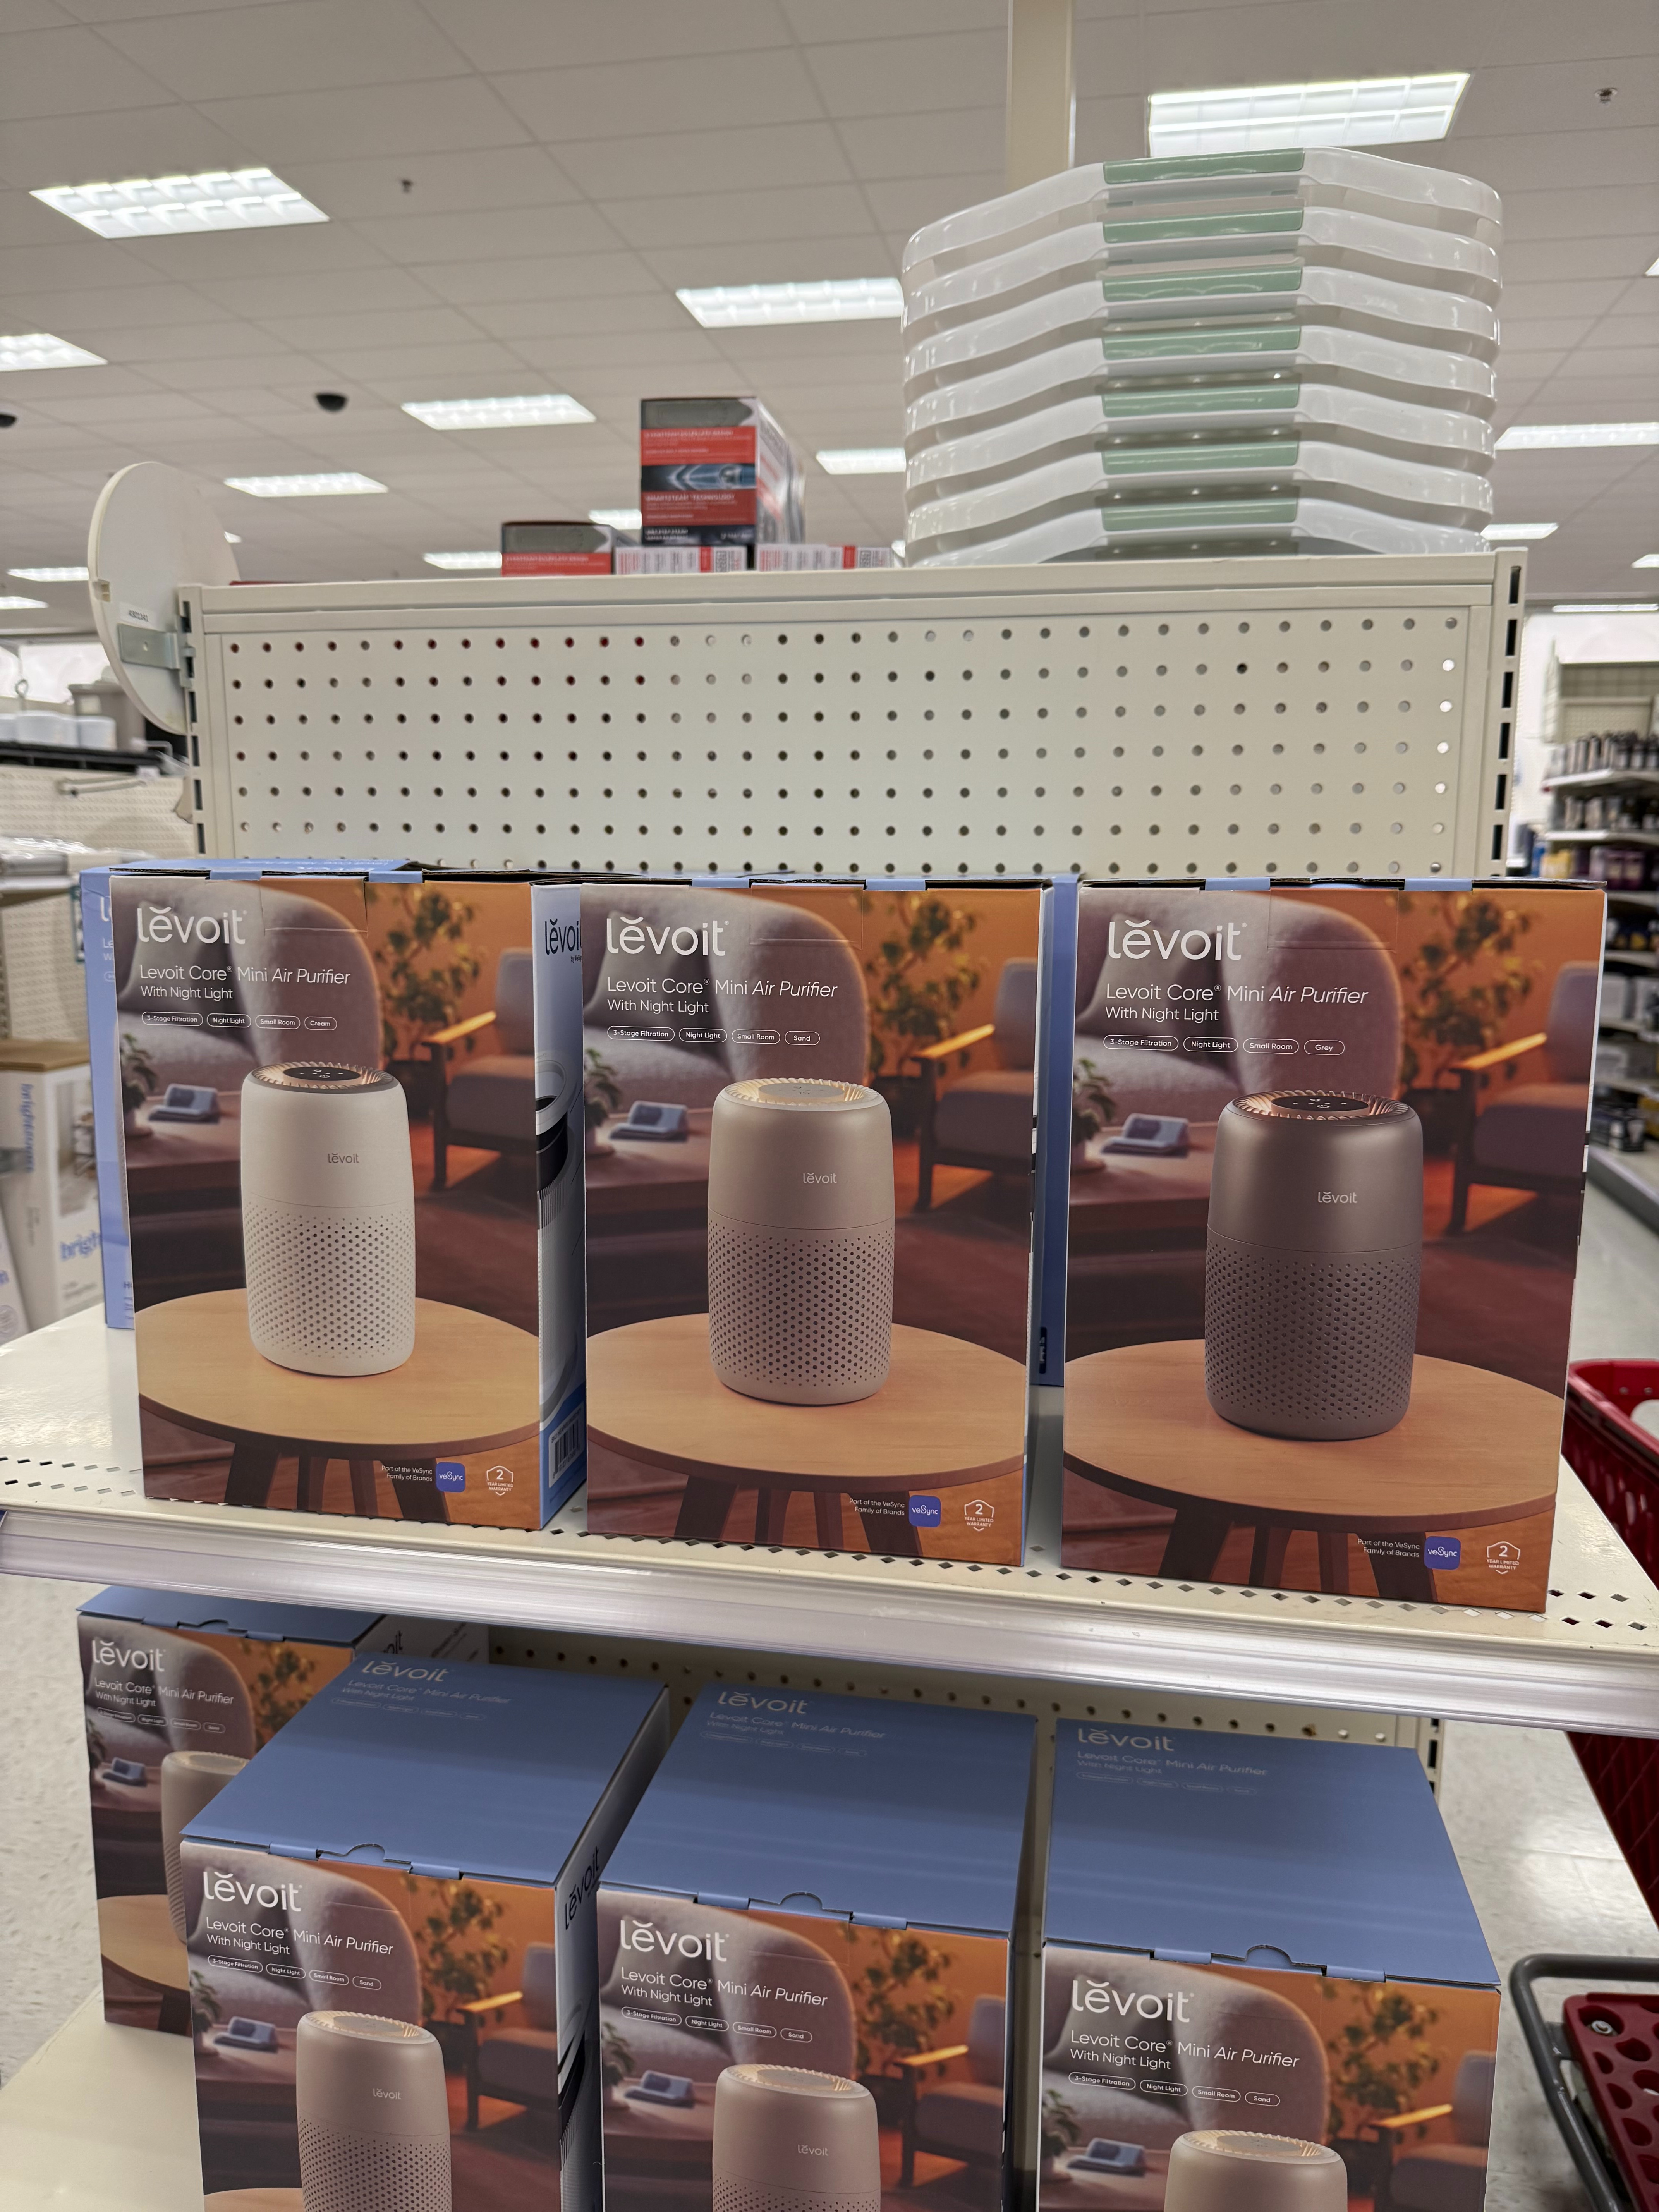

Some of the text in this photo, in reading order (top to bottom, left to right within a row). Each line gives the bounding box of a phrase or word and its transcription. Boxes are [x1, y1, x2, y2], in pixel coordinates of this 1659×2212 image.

[141, 965, 185, 979] Levoit
[238, 967, 267, 981] Mini
[272, 968, 293, 982] Air
[297, 969, 350, 984] Purifier
[141, 986, 233, 1001] With Night Light
[608, 977, 656, 992] Levoit
[716, 980, 747, 994] Mini
[752, 981, 775, 995] Air
[780, 981, 838, 997] Purifier
[1107, 984, 1161, 999] Levoit
[1228, 986, 1264, 1001] Mini
[1269, 986, 1296, 1002] Air
[1301, 987, 1369, 1003] Purifier
[608, 999, 709, 1015] With Night Light
[1106, 1007, 1219, 1023] With Night Light
[496, 1470, 504, 1479] 2
[975, 1504, 983, 1514] 2
[1364, 1547, 1385, 1555] Family
[1499, 1546, 1507, 1557] 2
[94, 1678, 123, 1691] Levoit
[158, 1686, 179, 1697] Mini
[181, 1689, 196, 1699] Air
[198, 1691, 234, 1704] Purifier
[207, 1917, 246, 1934] Levoit
[294, 1929, 320, 1944] Mini
[324, 1934, 342, 1947] Air
[346, 1937, 393, 1954] Purifier
[207, 1934, 290, 1954] With Night Light
[622, 1967, 665, 1985] Levoit
[718, 1980, 746, 1995] Mini
[750, 1985, 771, 1997] Air
[775, 1988, 828, 2006] Purifier
[622, 1985, 712, 2006] With Night Light
[627, 2010, 650, 2019] 3-Stage
[1072, 2030, 1120, 2047] Levoit
[1178, 2042, 1210, 2057] Mini
[1214, 2047, 1238, 2060] Air
[1242, 2049, 1300, 2067] Purifier
[1070, 2049, 1171, 2070] With Night Light
